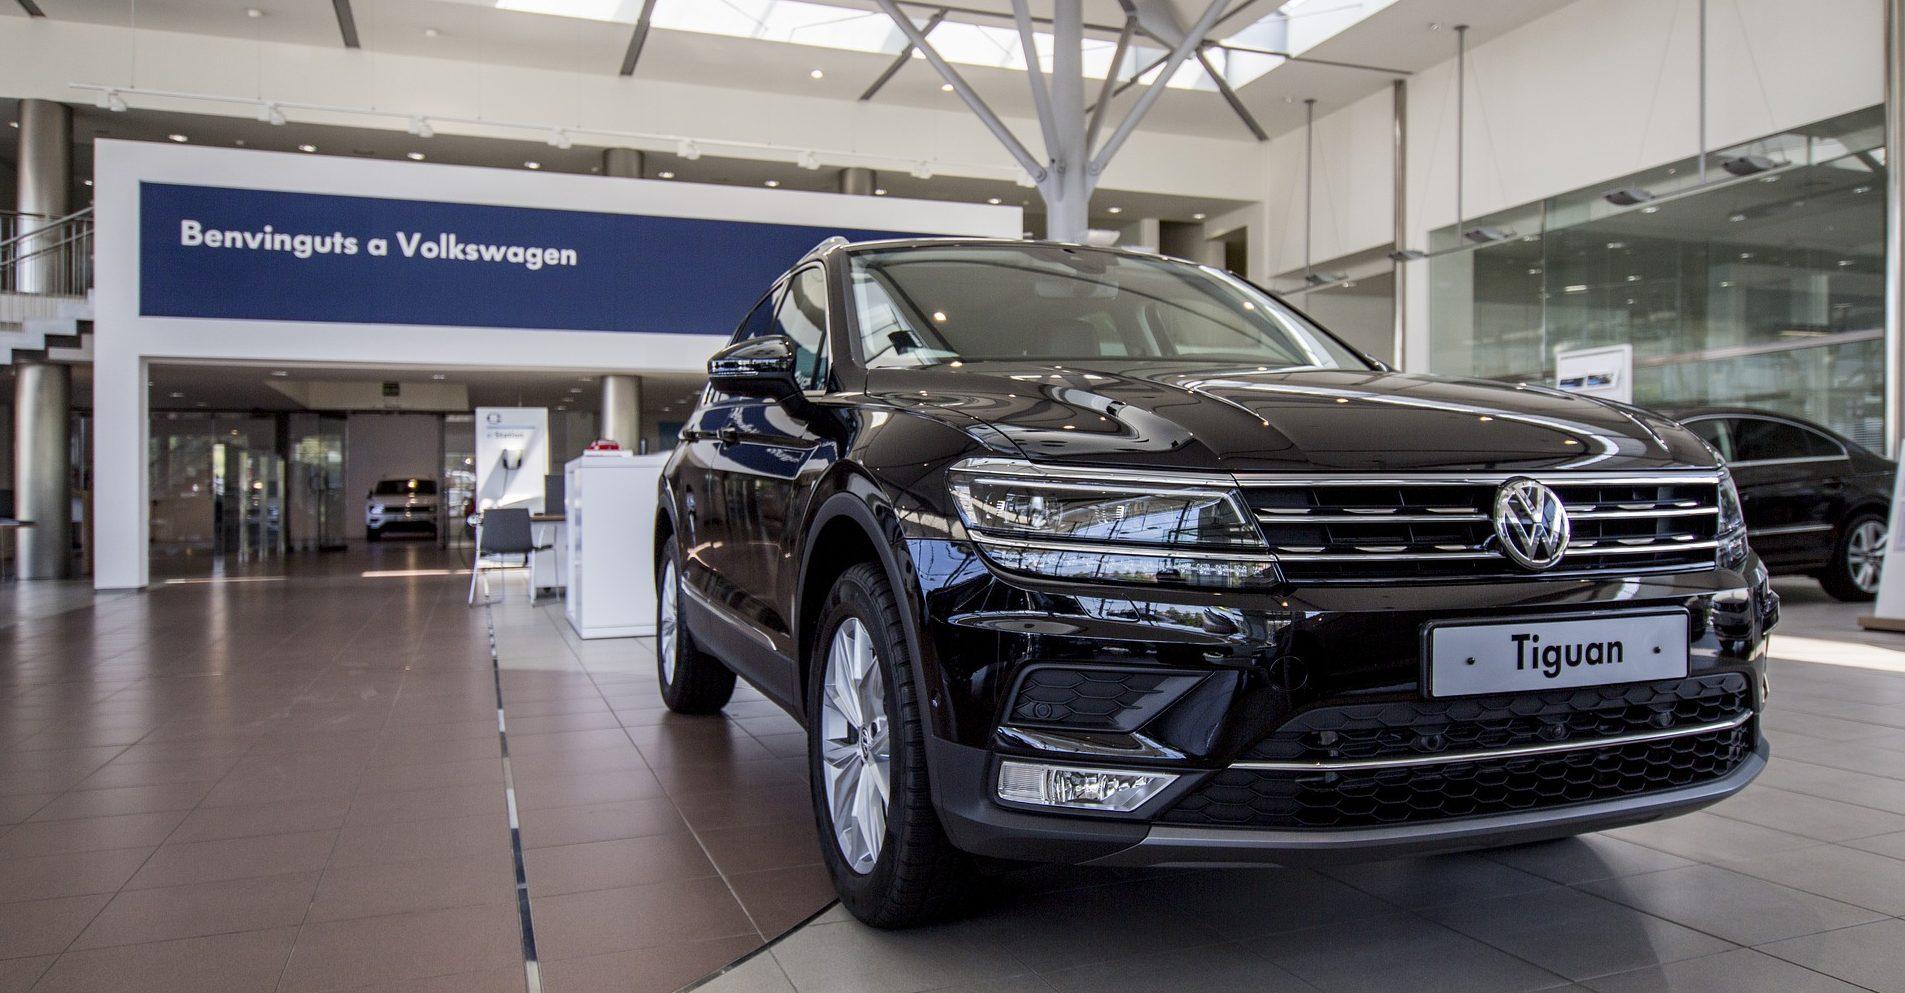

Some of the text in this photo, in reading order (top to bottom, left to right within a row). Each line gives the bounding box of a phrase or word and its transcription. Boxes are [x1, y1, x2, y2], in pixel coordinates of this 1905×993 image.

[181, 219, 577, 271] Benvinguts a Volkswagen
[1496, 479, 1569, 567] VW
[1511, 634, 1624, 679] Tiguan
